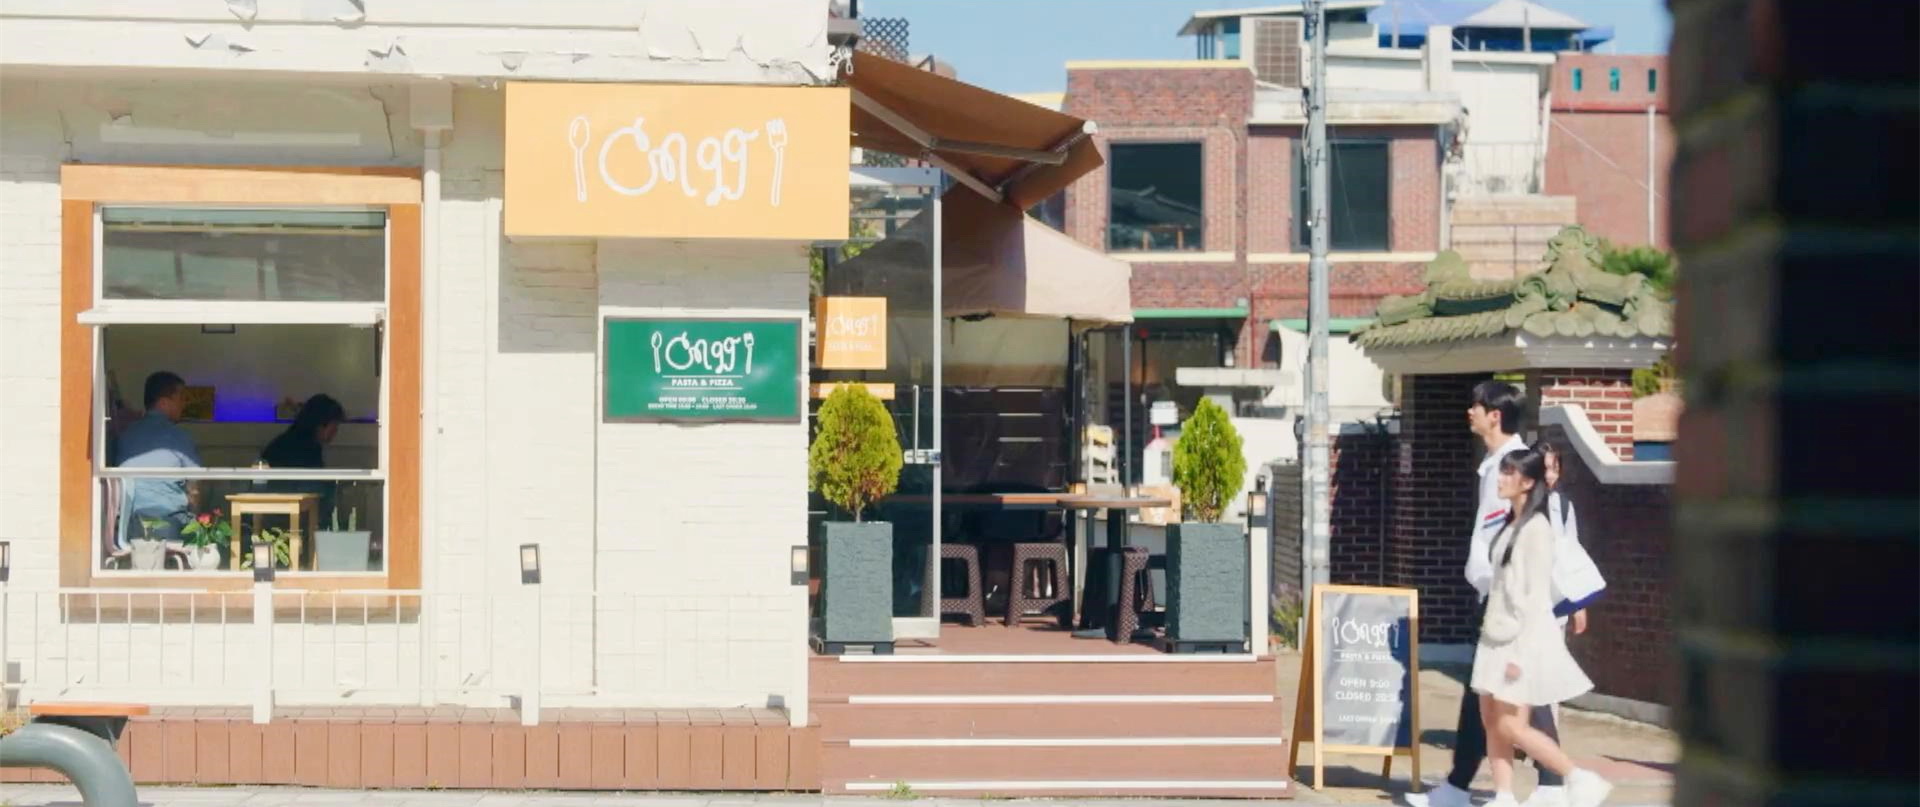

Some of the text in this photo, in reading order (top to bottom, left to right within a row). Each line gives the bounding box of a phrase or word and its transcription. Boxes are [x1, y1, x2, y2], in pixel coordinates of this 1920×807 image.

[671, 379, 734, 387] PASTA & PIZZA
[702, 396, 727, 404] CLOSED
[1340, 678, 1367, 688] OPEN
[1335, 690, 1372, 701] CLOSED
